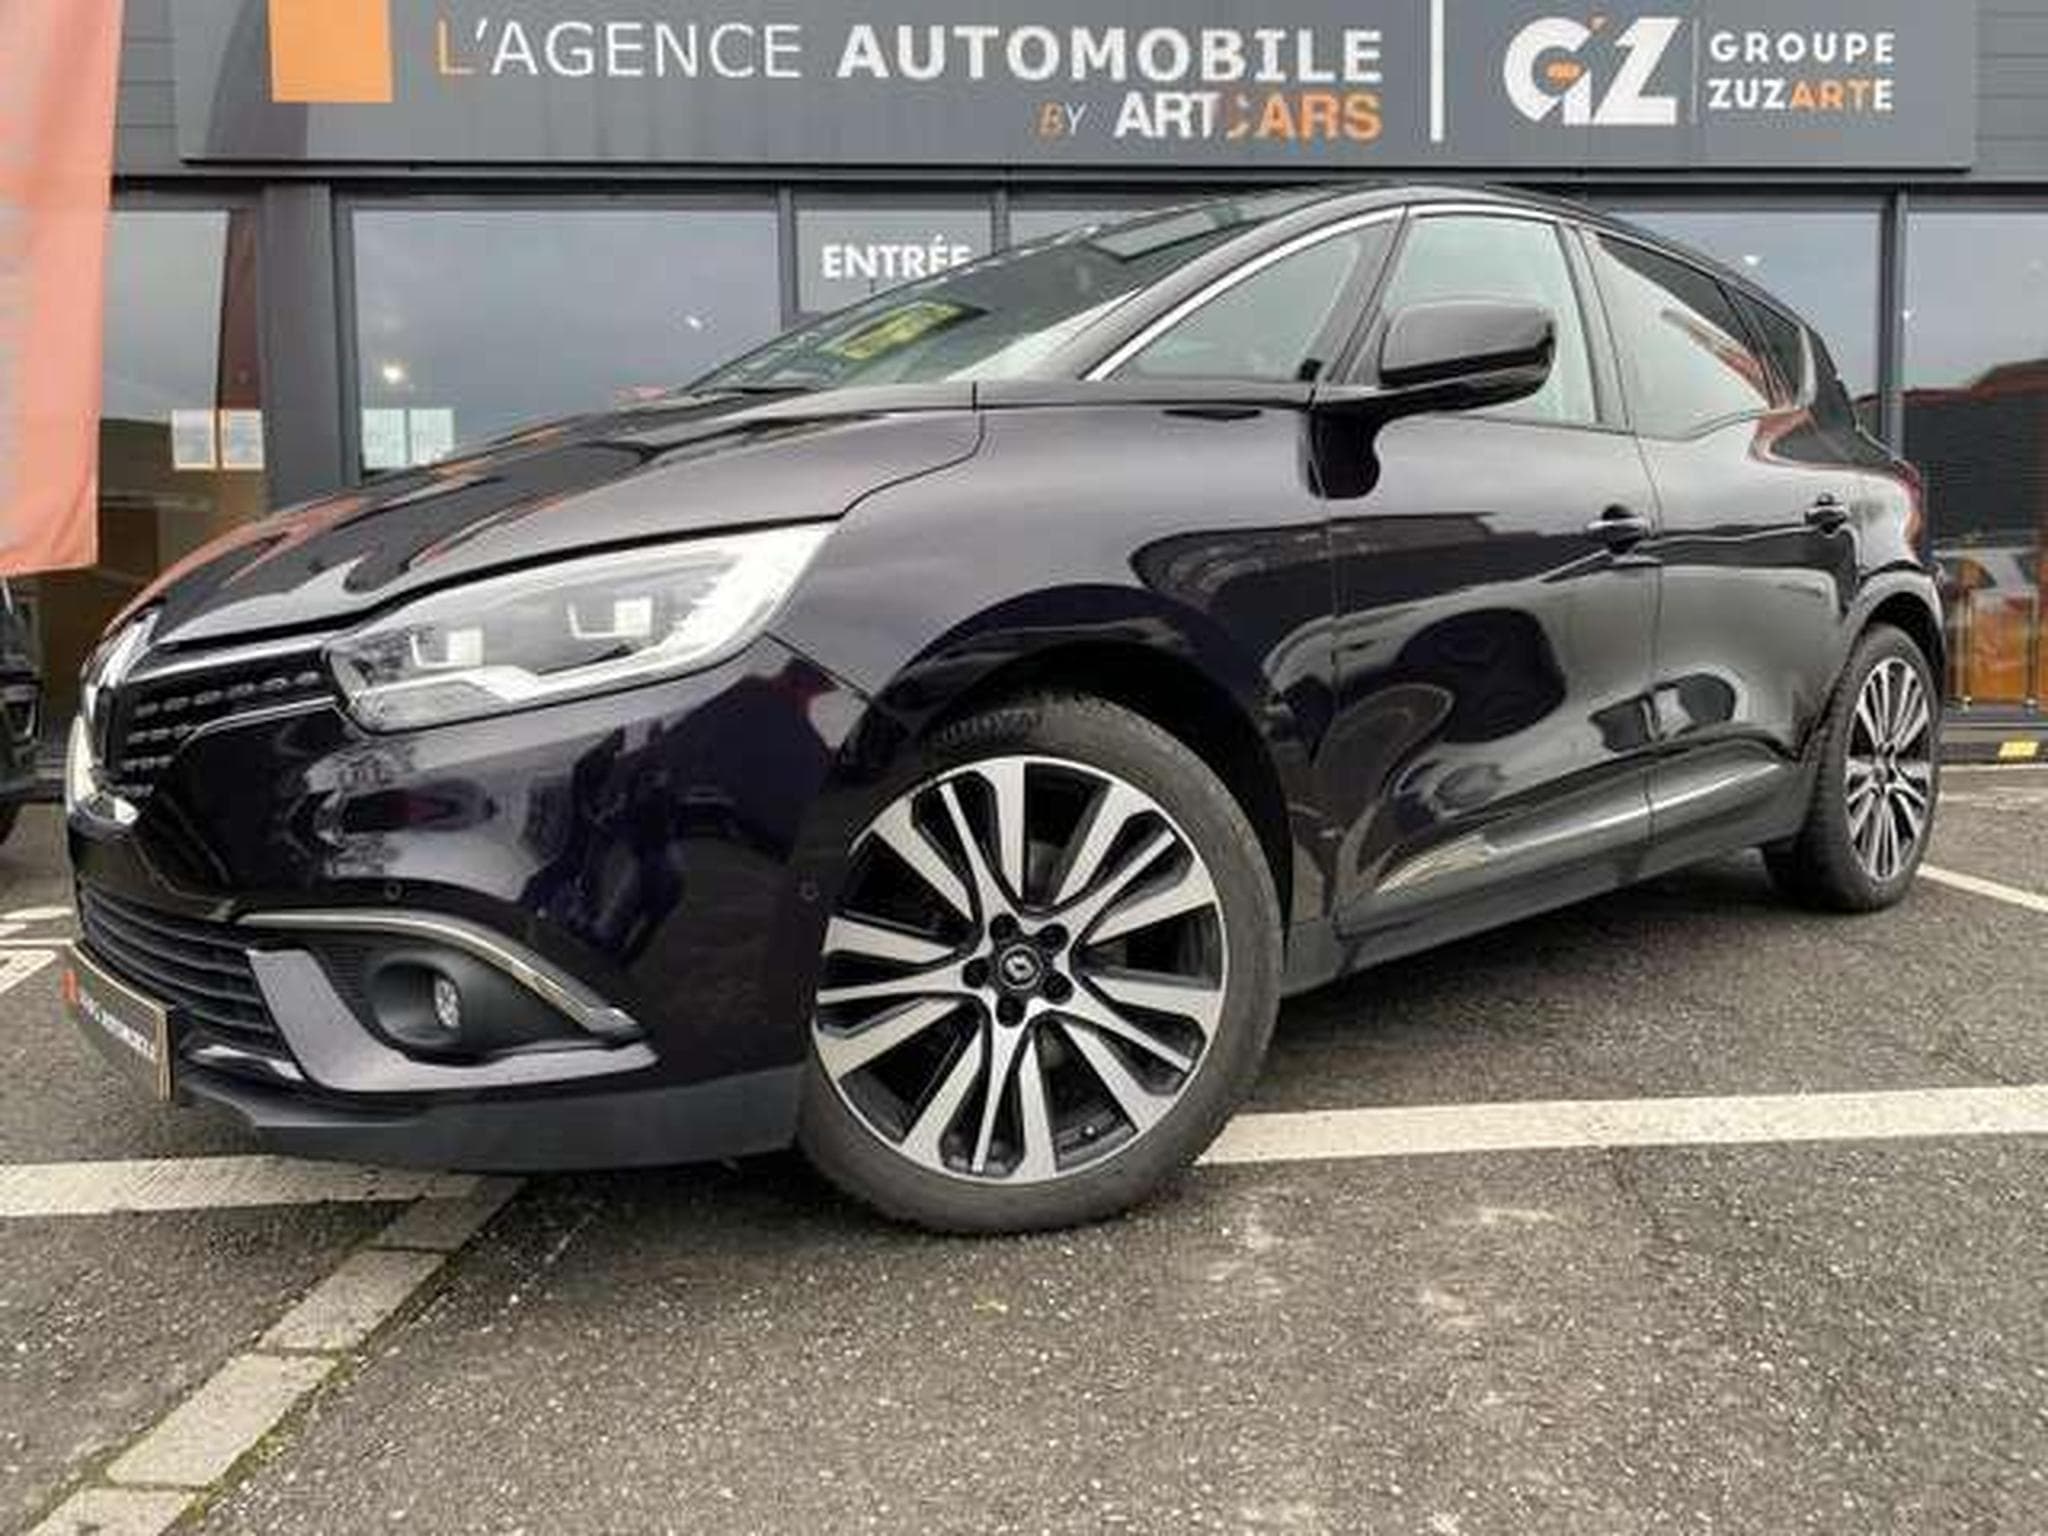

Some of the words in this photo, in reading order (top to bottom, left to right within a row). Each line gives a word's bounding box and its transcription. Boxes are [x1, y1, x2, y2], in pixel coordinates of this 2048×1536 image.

[436, 19, 803, 78] L'AGENCE
[836, 25, 1383, 83] AUTOMOBILE
[1710, 32, 1895, 63] GROUPE
[1708, 78, 1895, 111] ZUZARTE
[1039, 101, 1086, 139] BY
